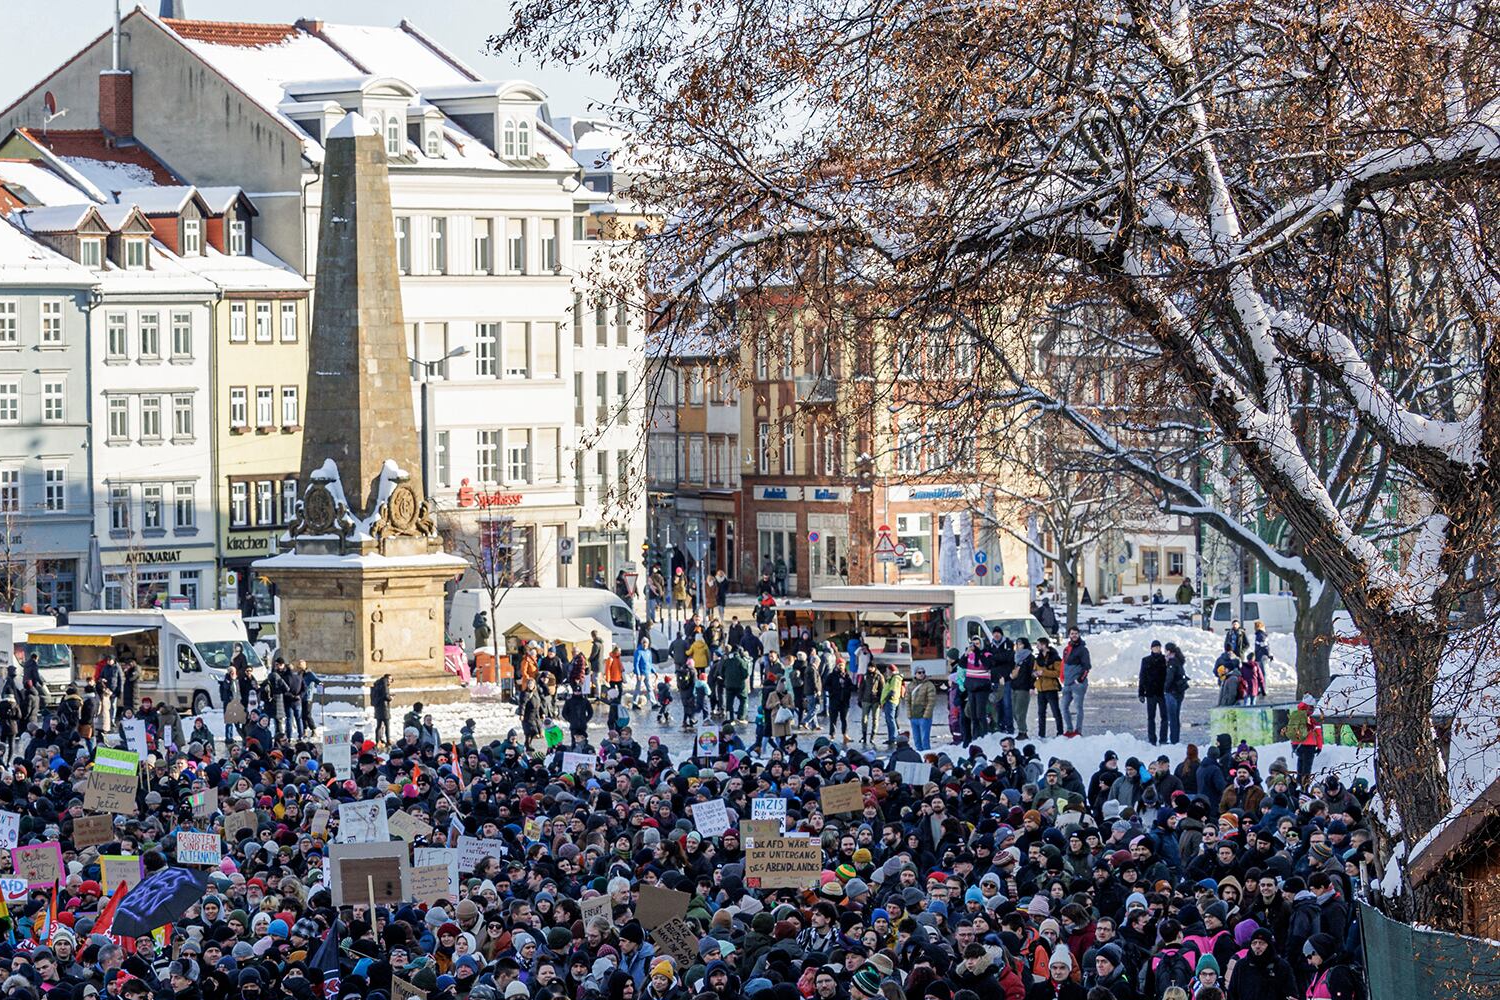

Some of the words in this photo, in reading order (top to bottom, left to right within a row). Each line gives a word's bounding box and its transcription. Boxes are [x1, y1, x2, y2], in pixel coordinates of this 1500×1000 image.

[88, 773, 106, 791] Nie
[108, 779, 135, 794] wieder
[754, 799, 784, 811] NAZIS
[766, 840, 784, 849] AFD
[769, 850, 817, 860] UNTERGANG
[765, 862, 821, 873] ABENDLANDES
